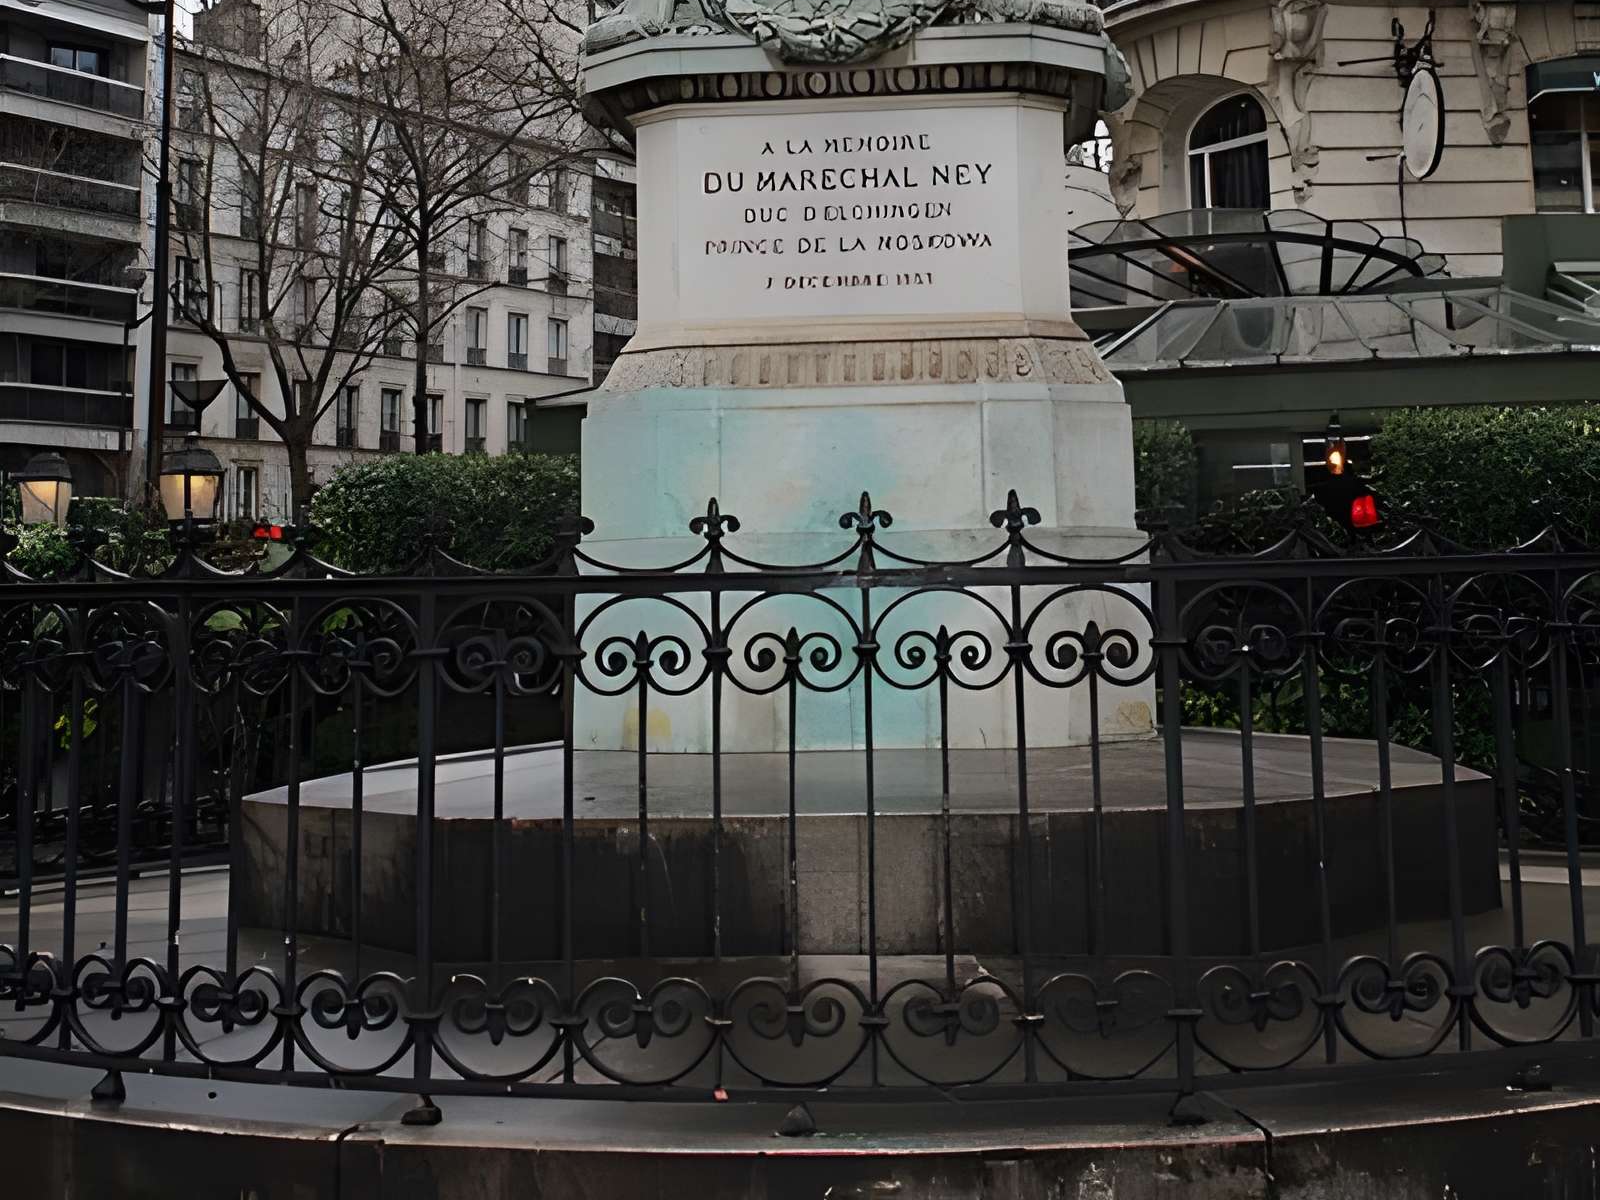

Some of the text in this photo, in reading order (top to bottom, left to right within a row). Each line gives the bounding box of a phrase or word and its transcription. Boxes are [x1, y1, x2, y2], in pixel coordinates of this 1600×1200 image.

[761, 141, 776, 156] A
[786, 139, 814, 155] LA
[704, 163, 992, 195] DU MARECHAL NEY
[744, 207, 788, 224] DUC
[798, 237, 827, 255] DE
[839, 236, 867, 253] LA
